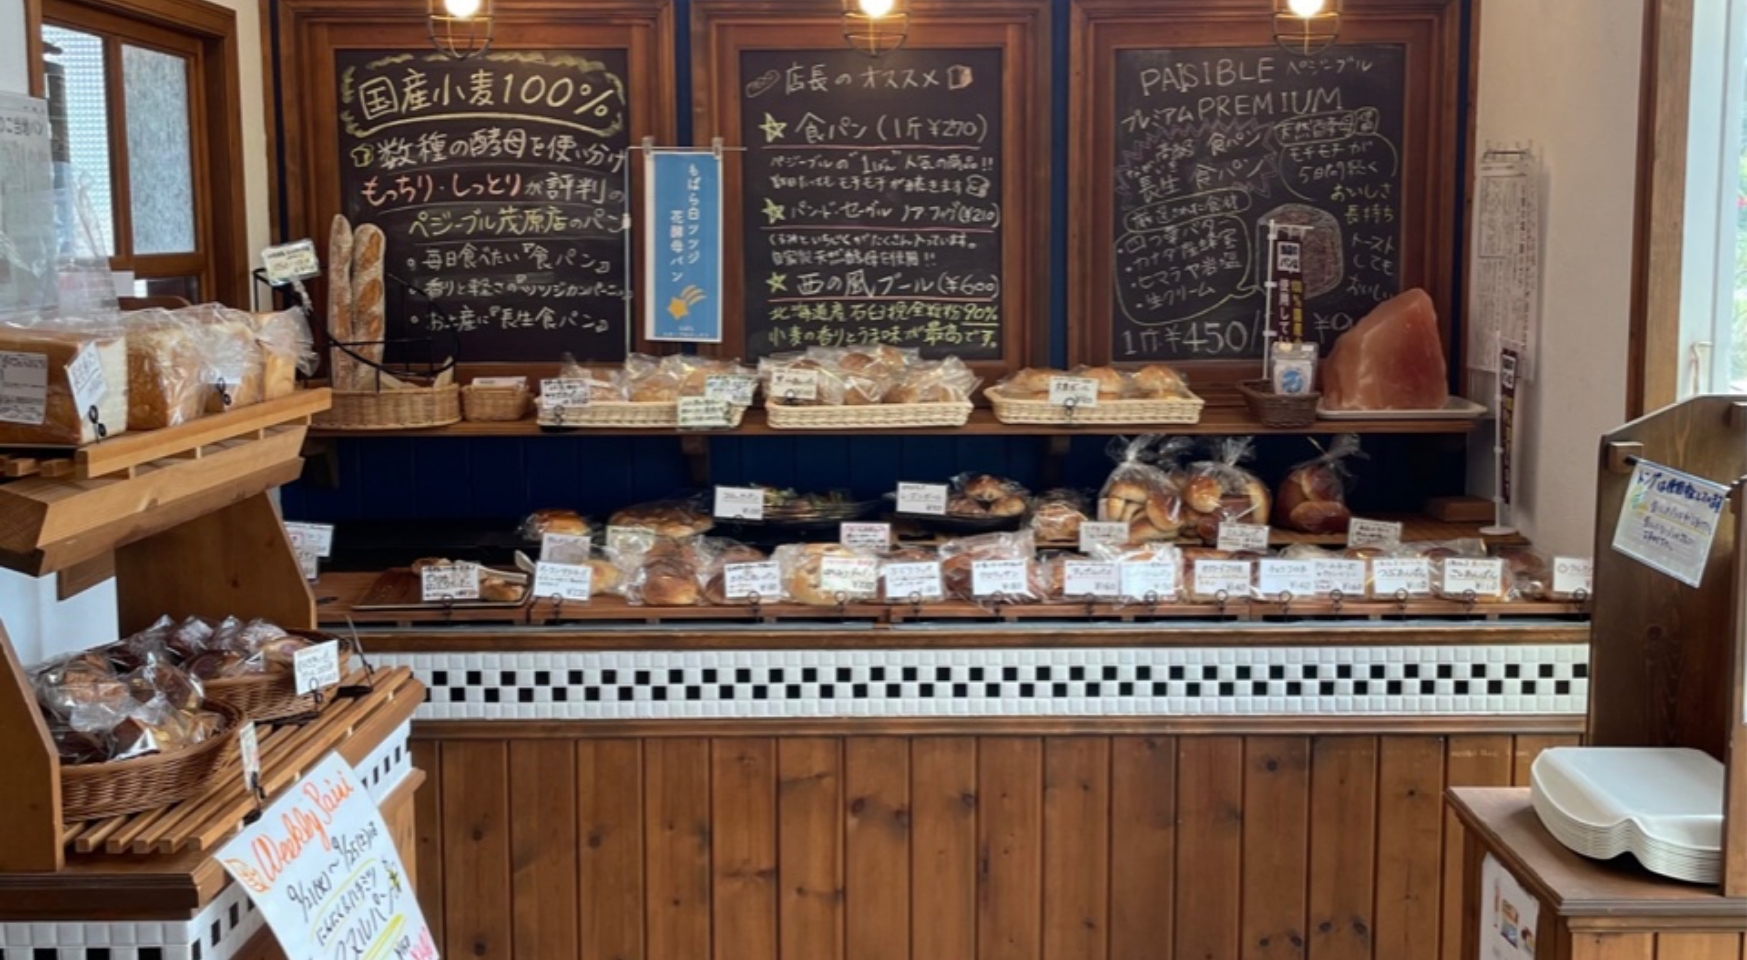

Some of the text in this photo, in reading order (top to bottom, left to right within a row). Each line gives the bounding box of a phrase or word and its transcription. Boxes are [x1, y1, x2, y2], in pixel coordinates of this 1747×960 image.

[359, 67, 614, 120] 国産小麦100%
[1198, 88, 1343, 120] PREMIUM
